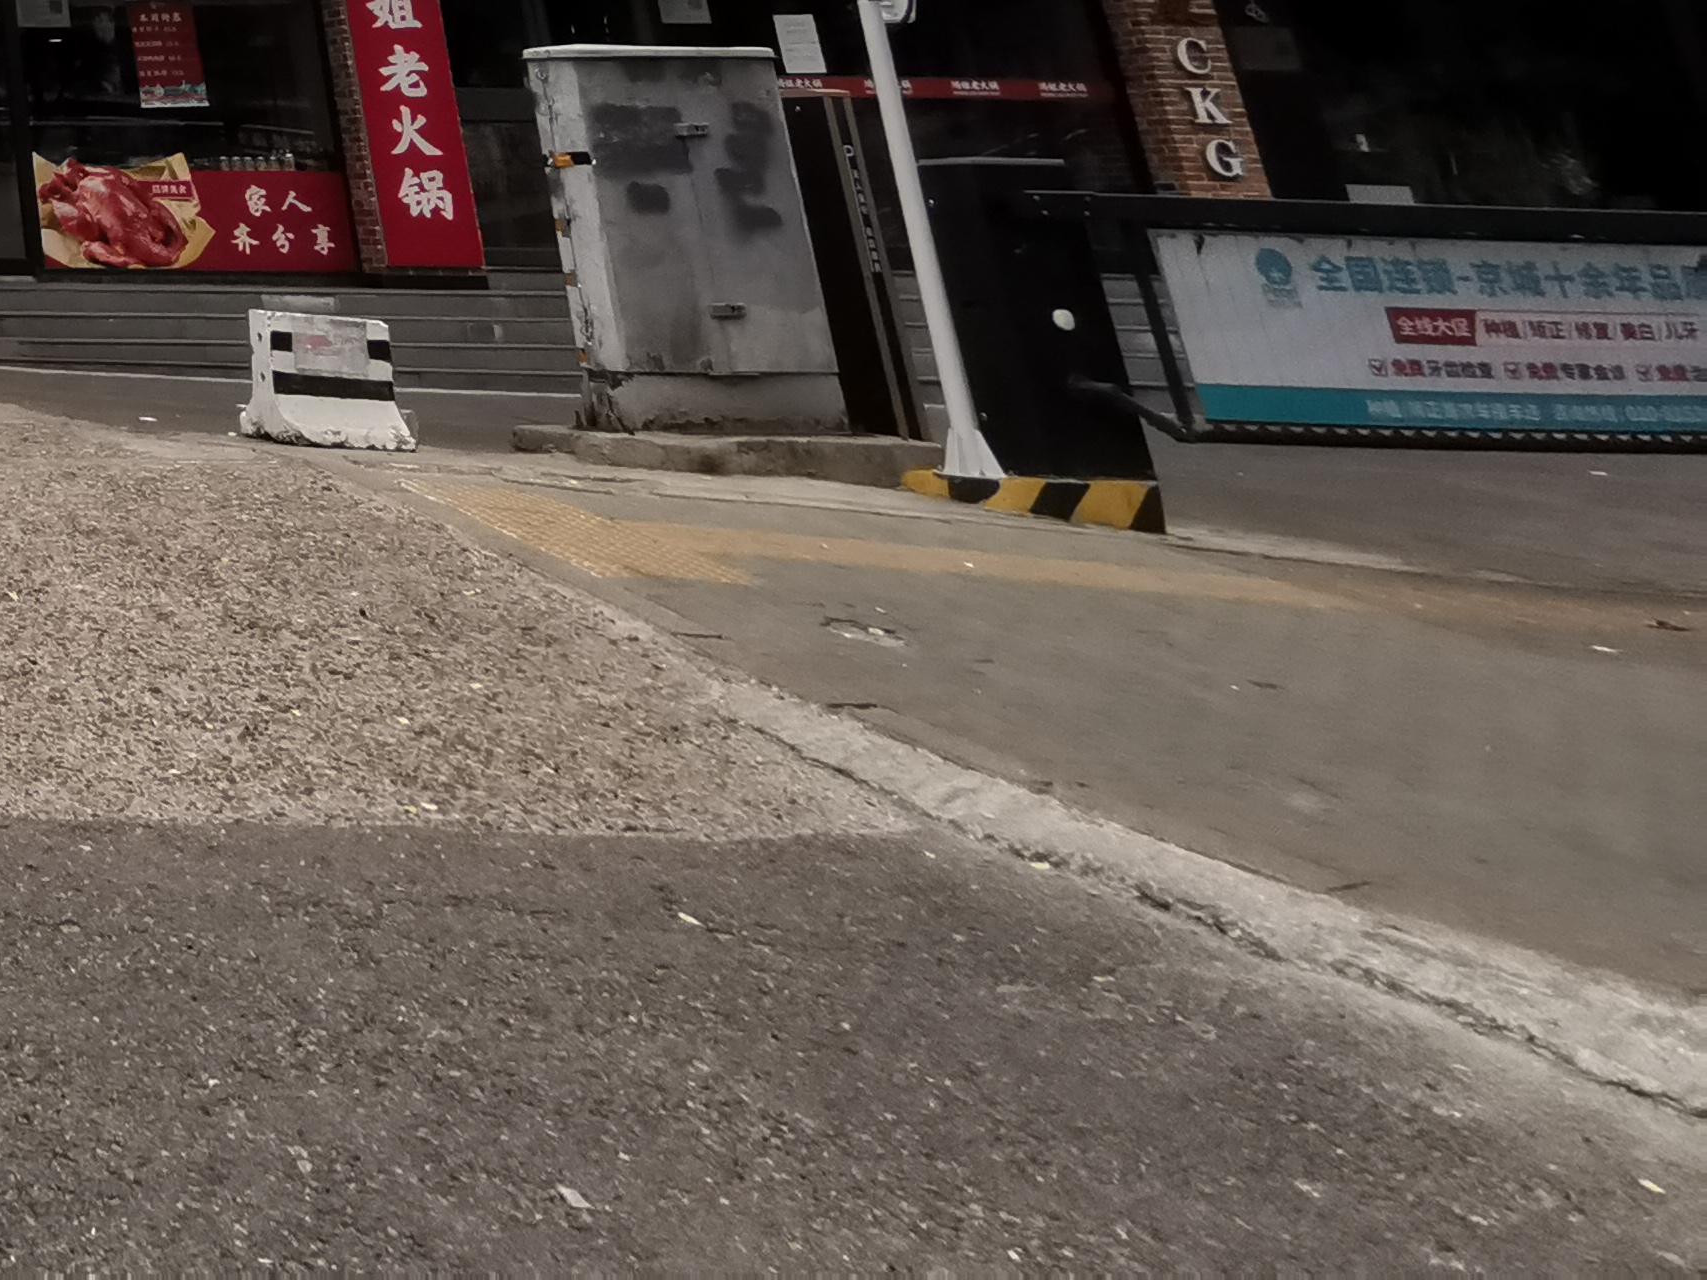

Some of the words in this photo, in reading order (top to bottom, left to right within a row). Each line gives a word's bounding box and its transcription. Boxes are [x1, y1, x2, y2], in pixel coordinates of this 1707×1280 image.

[244, 184, 314, 218] 家人
[230, 222, 336, 256] 齐分享
